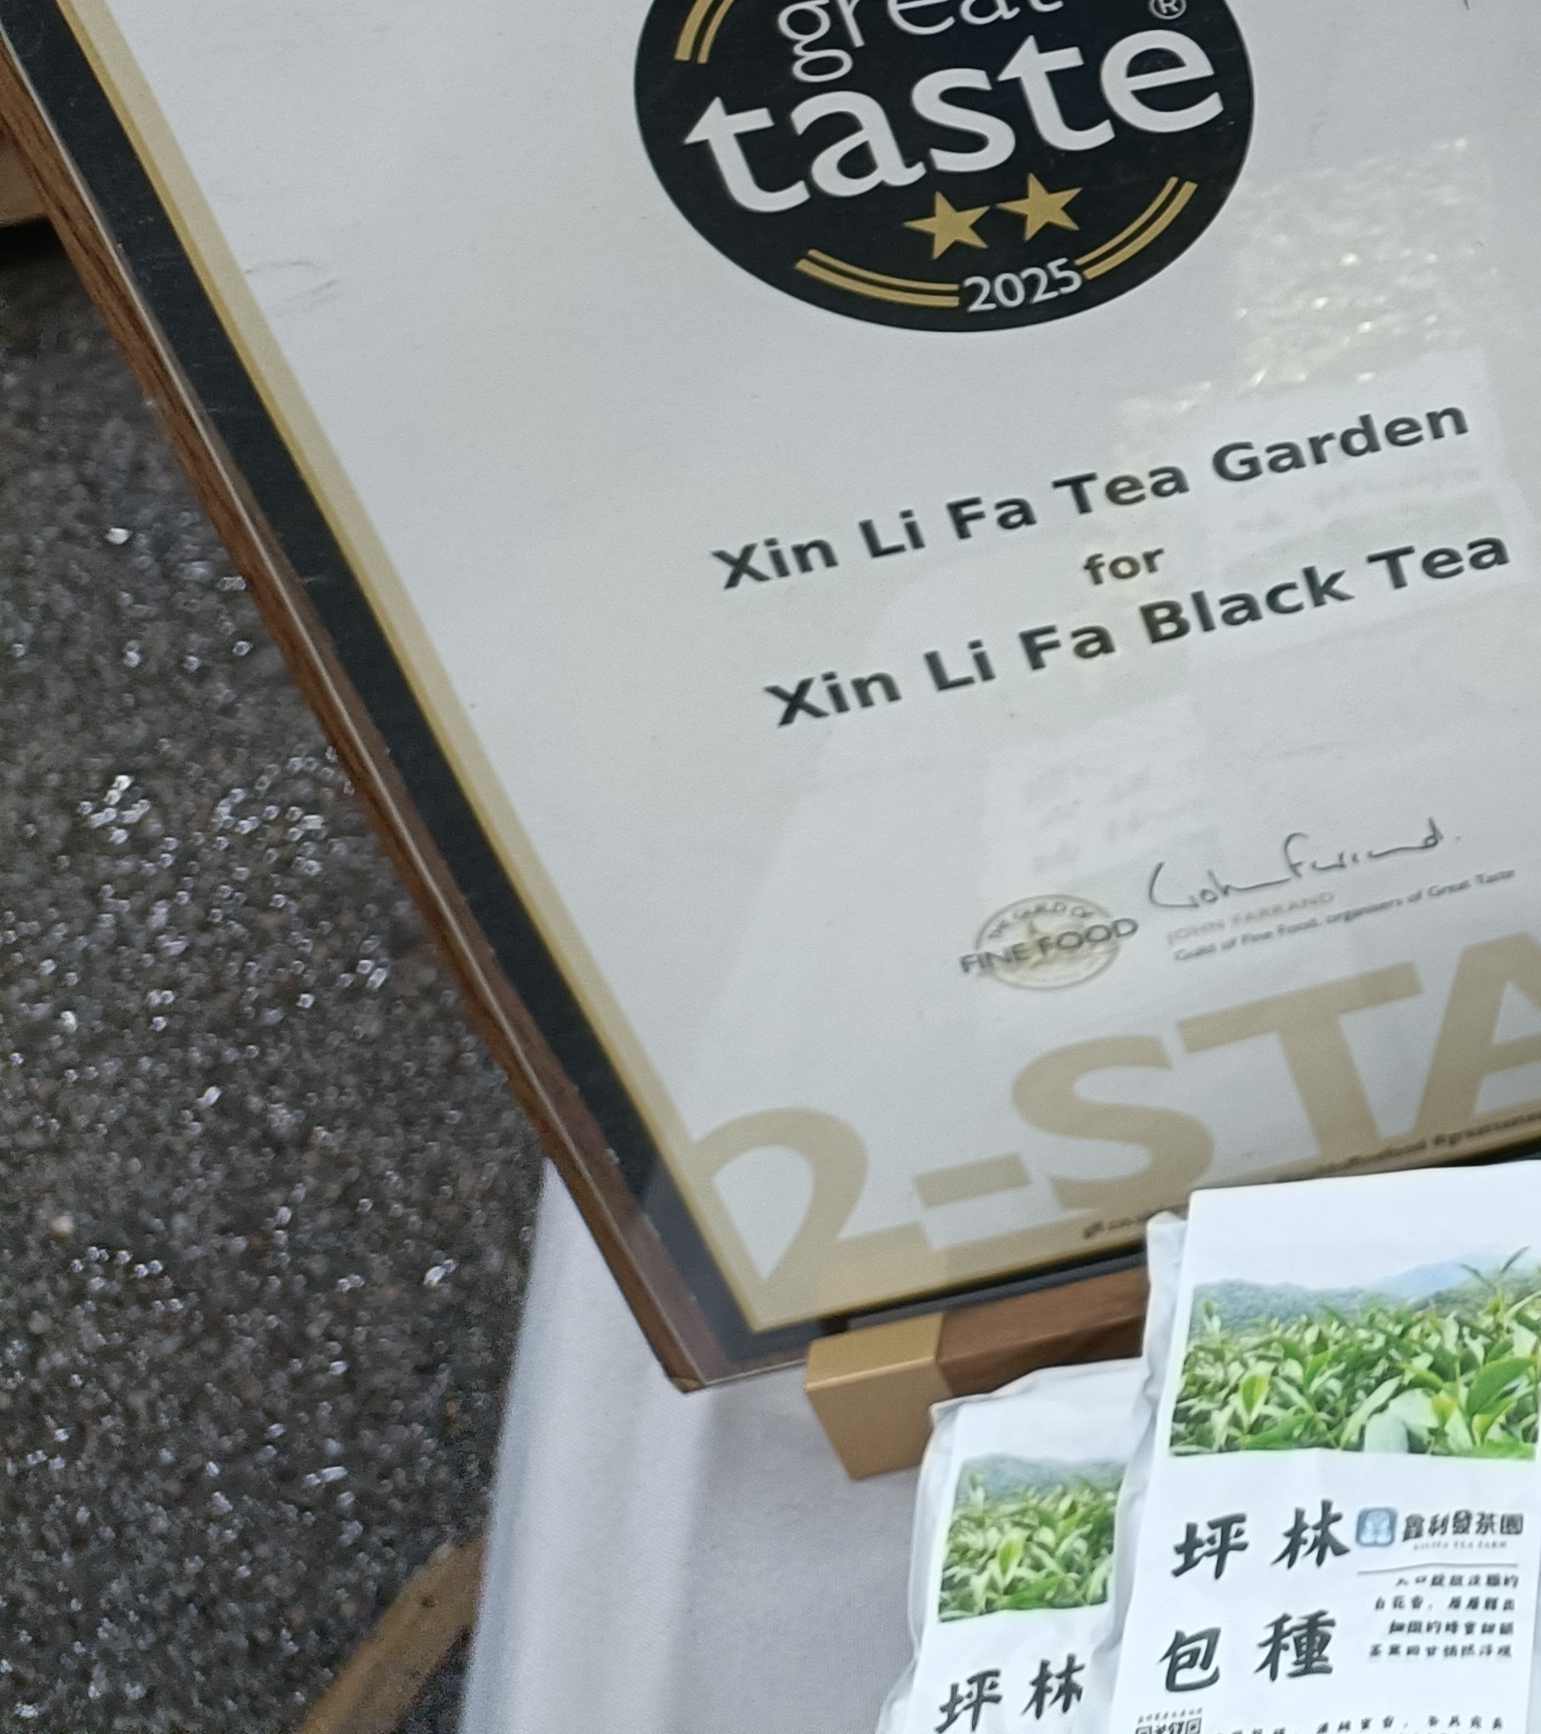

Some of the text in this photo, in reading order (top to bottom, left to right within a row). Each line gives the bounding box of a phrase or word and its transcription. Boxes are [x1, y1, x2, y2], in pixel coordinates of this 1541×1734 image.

[683, 29, 1223, 212] taste
[963, 256, 1084, 313] 2025
[711, 397, 1470, 590] Xin Li Fa Tea Garden
[1083, 541, 1166, 587] for
[764, 529, 1511, 728] Xin Li Fa Black Tea
[959, 916, 1138, 974] FINE FOOD
[1171, 1499, 1350, 1580] 坪林
[1158, 1609, 1336, 1693] 包種
[936, 1653, 1085, 1734] 坪林
